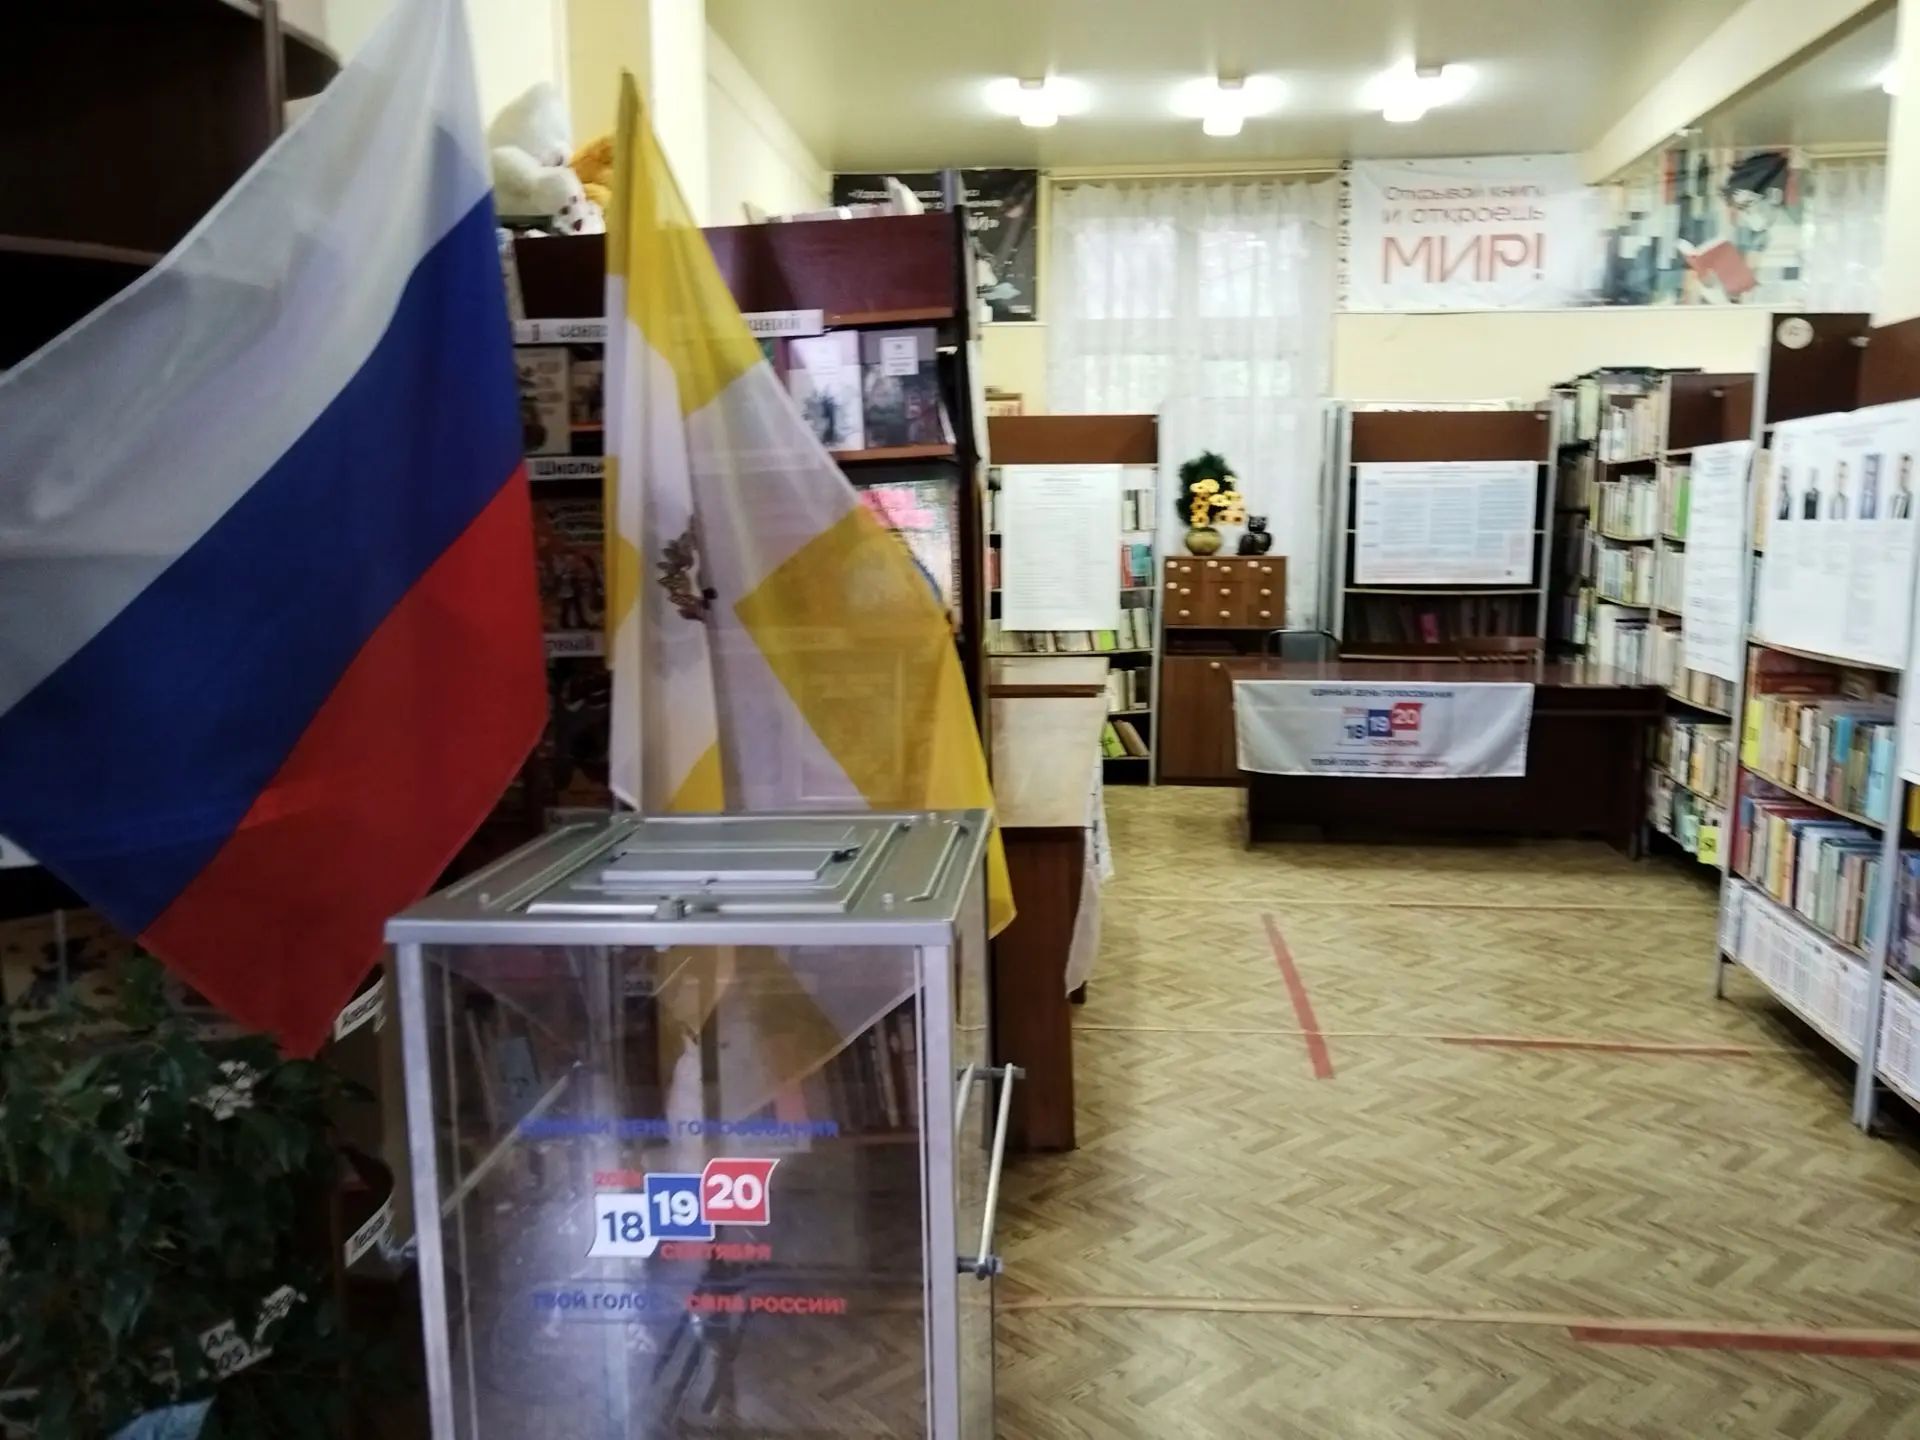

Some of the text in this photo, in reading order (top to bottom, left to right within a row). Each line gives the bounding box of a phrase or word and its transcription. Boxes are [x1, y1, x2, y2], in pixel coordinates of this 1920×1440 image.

[1409, 205, 1545, 226] откроешь
[1382, 233, 1545, 284] МИР!
[1344, 708, 1419, 740] 18 19 20
[602, 1174, 763, 1242] 18 19 20
[592, 1290, 660, 1311] ГОЛО
